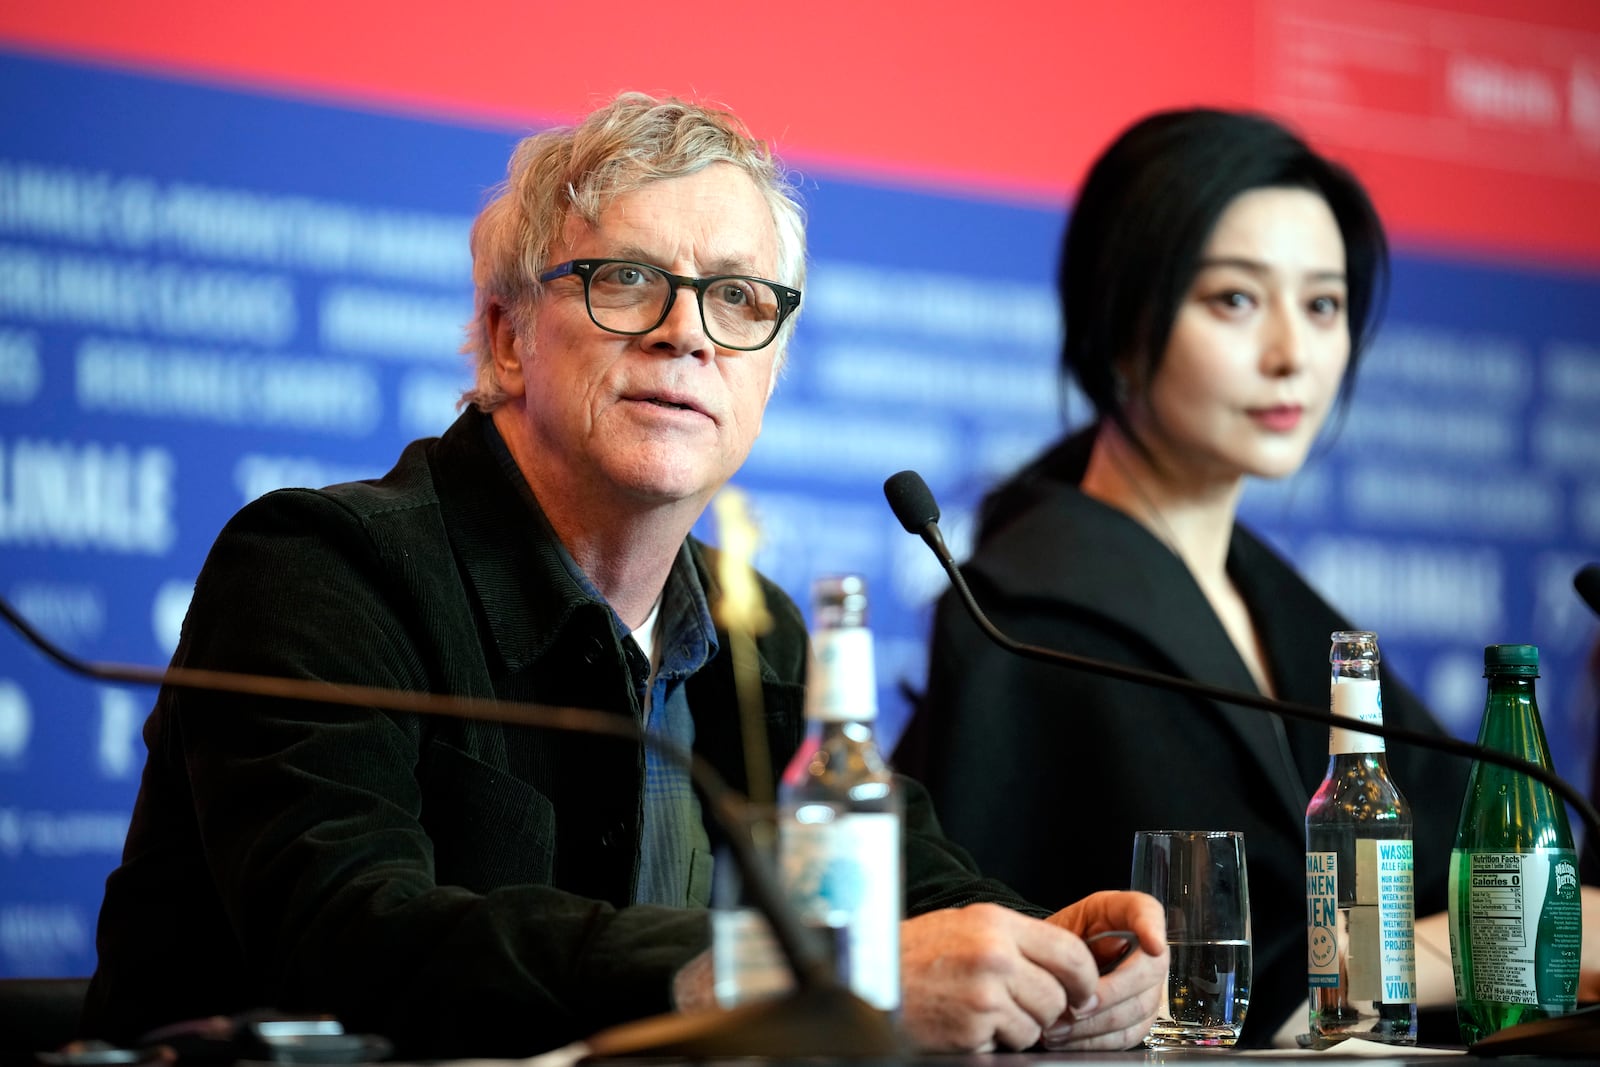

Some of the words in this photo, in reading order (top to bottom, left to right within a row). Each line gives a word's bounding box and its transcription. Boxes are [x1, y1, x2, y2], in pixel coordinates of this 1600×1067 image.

[1473, 855, 1499, 863] Nutrition
[1502, 855, 1519, 863] Facts
[1512, 876, 1519, 885] 0
[1386, 982, 1410, 999] VIVA
